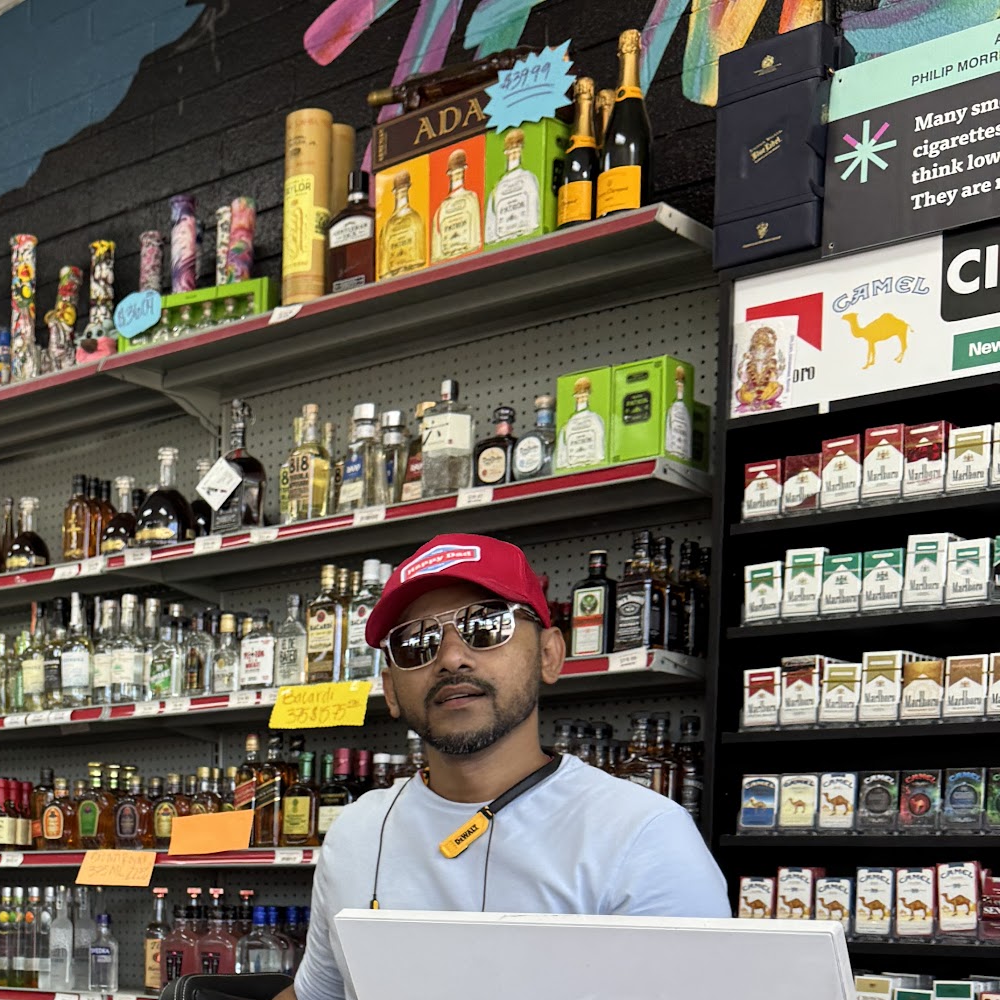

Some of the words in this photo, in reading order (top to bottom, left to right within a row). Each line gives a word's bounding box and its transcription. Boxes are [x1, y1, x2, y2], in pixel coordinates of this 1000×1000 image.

[911, 64, 954, 87] PHILIP
[914, 101, 968, 134] Many
[912, 125, 1000, 159] cigarettes
[911, 155, 963, 185] think
[911, 188, 958, 211] They
[961, 179, 992, 198] are
[947, 244, 1000, 295] CI
[832, 275, 930, 314] CAMEL
[407, 553, 445, 576] Happy
[446, 549, 472, 560] Dad
[743, 883, 772, 895] CAMEL
[818, 884, 849, 895] CAMEL
